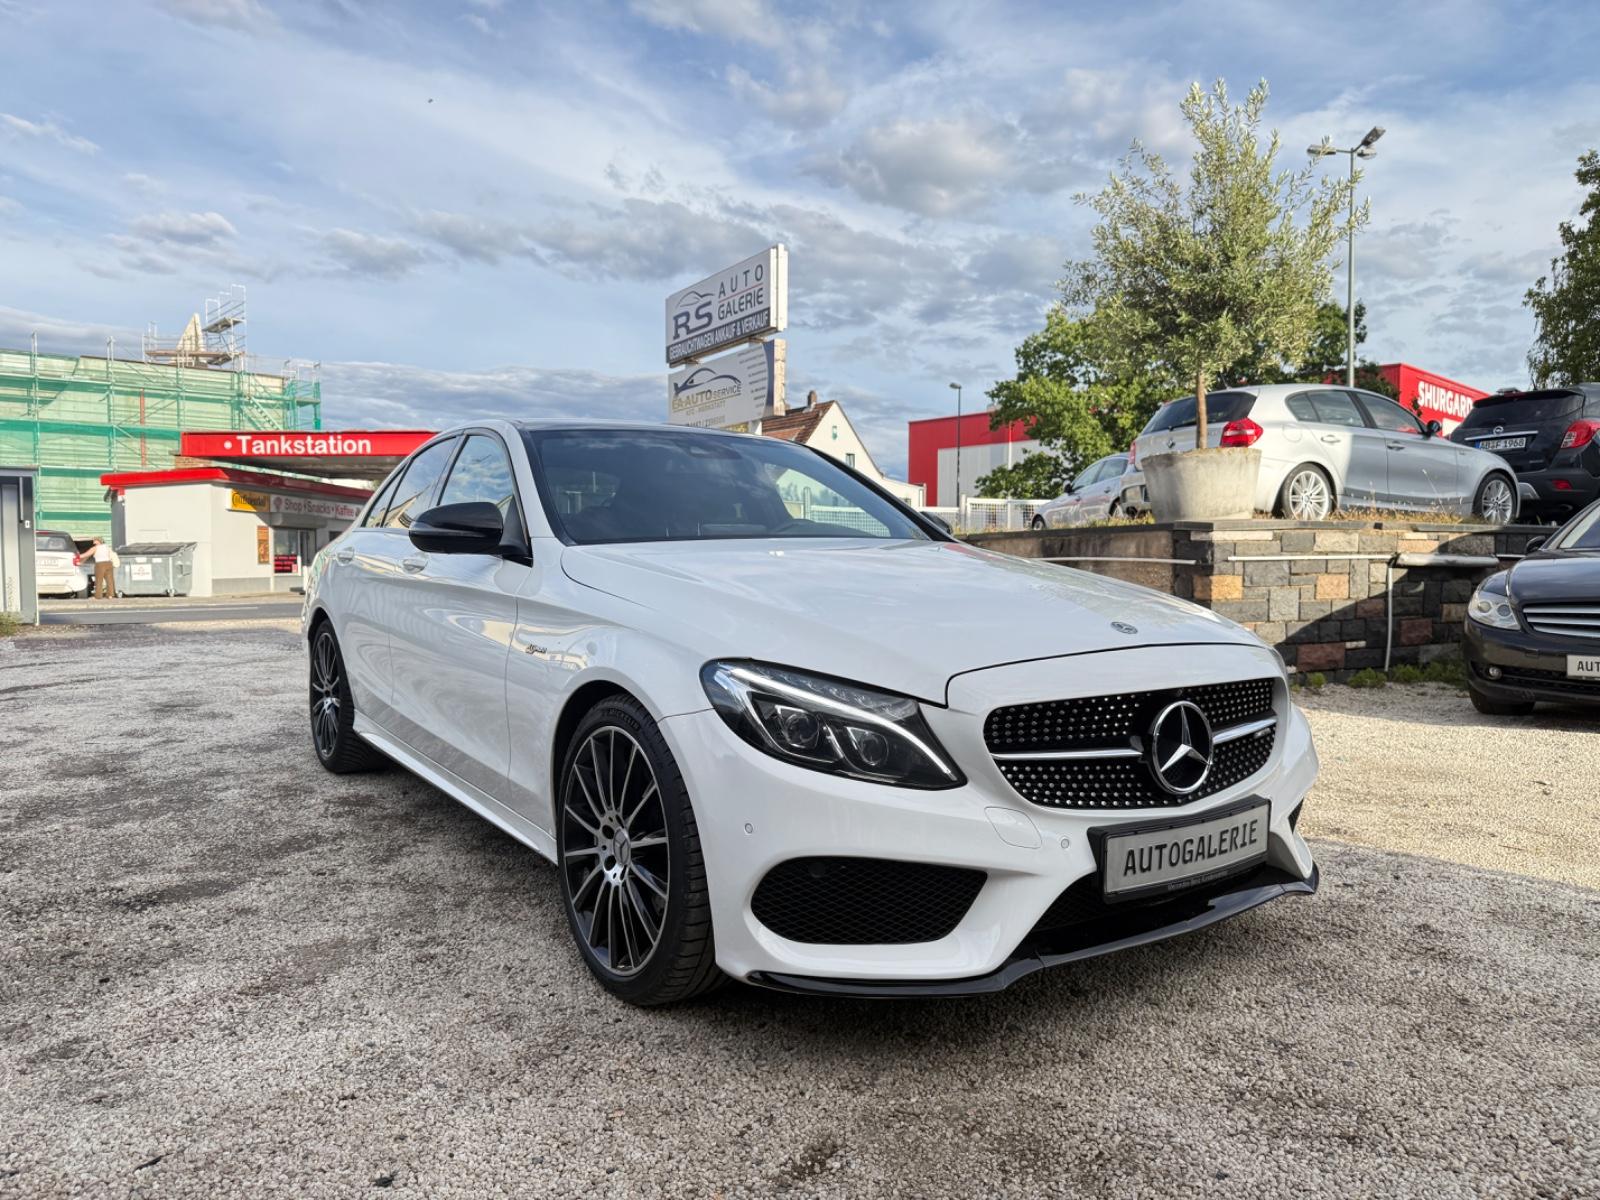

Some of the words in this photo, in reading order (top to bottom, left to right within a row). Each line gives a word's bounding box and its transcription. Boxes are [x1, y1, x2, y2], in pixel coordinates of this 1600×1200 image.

[718, 264, 763, 298] AUTO
[673, 301, 713, 340] RS
[717, 287, 763, 321] GALERIE
[669, 333, 714, 359] GEBRAUCHTWAGEN
[714, 323, 736, 345] ANKAUF
[742, 312, 768, 334] VERKAUF
[713, 382, 741, 400] SERVICE
[1417, 380, 1474, 420] SHURGARD
[236, 434, 372, 456] Tankstation
[1504, 438, 1524, 448] 1968
[285, 498, 303, 513] Shop
[307, 500, 331, 515] Snacks
[335, 503, 355, 518] Kaffee
[1577, 660, 1600, 672] AUT
[1124, 818, 1258, 877] AUTOGALERIE
